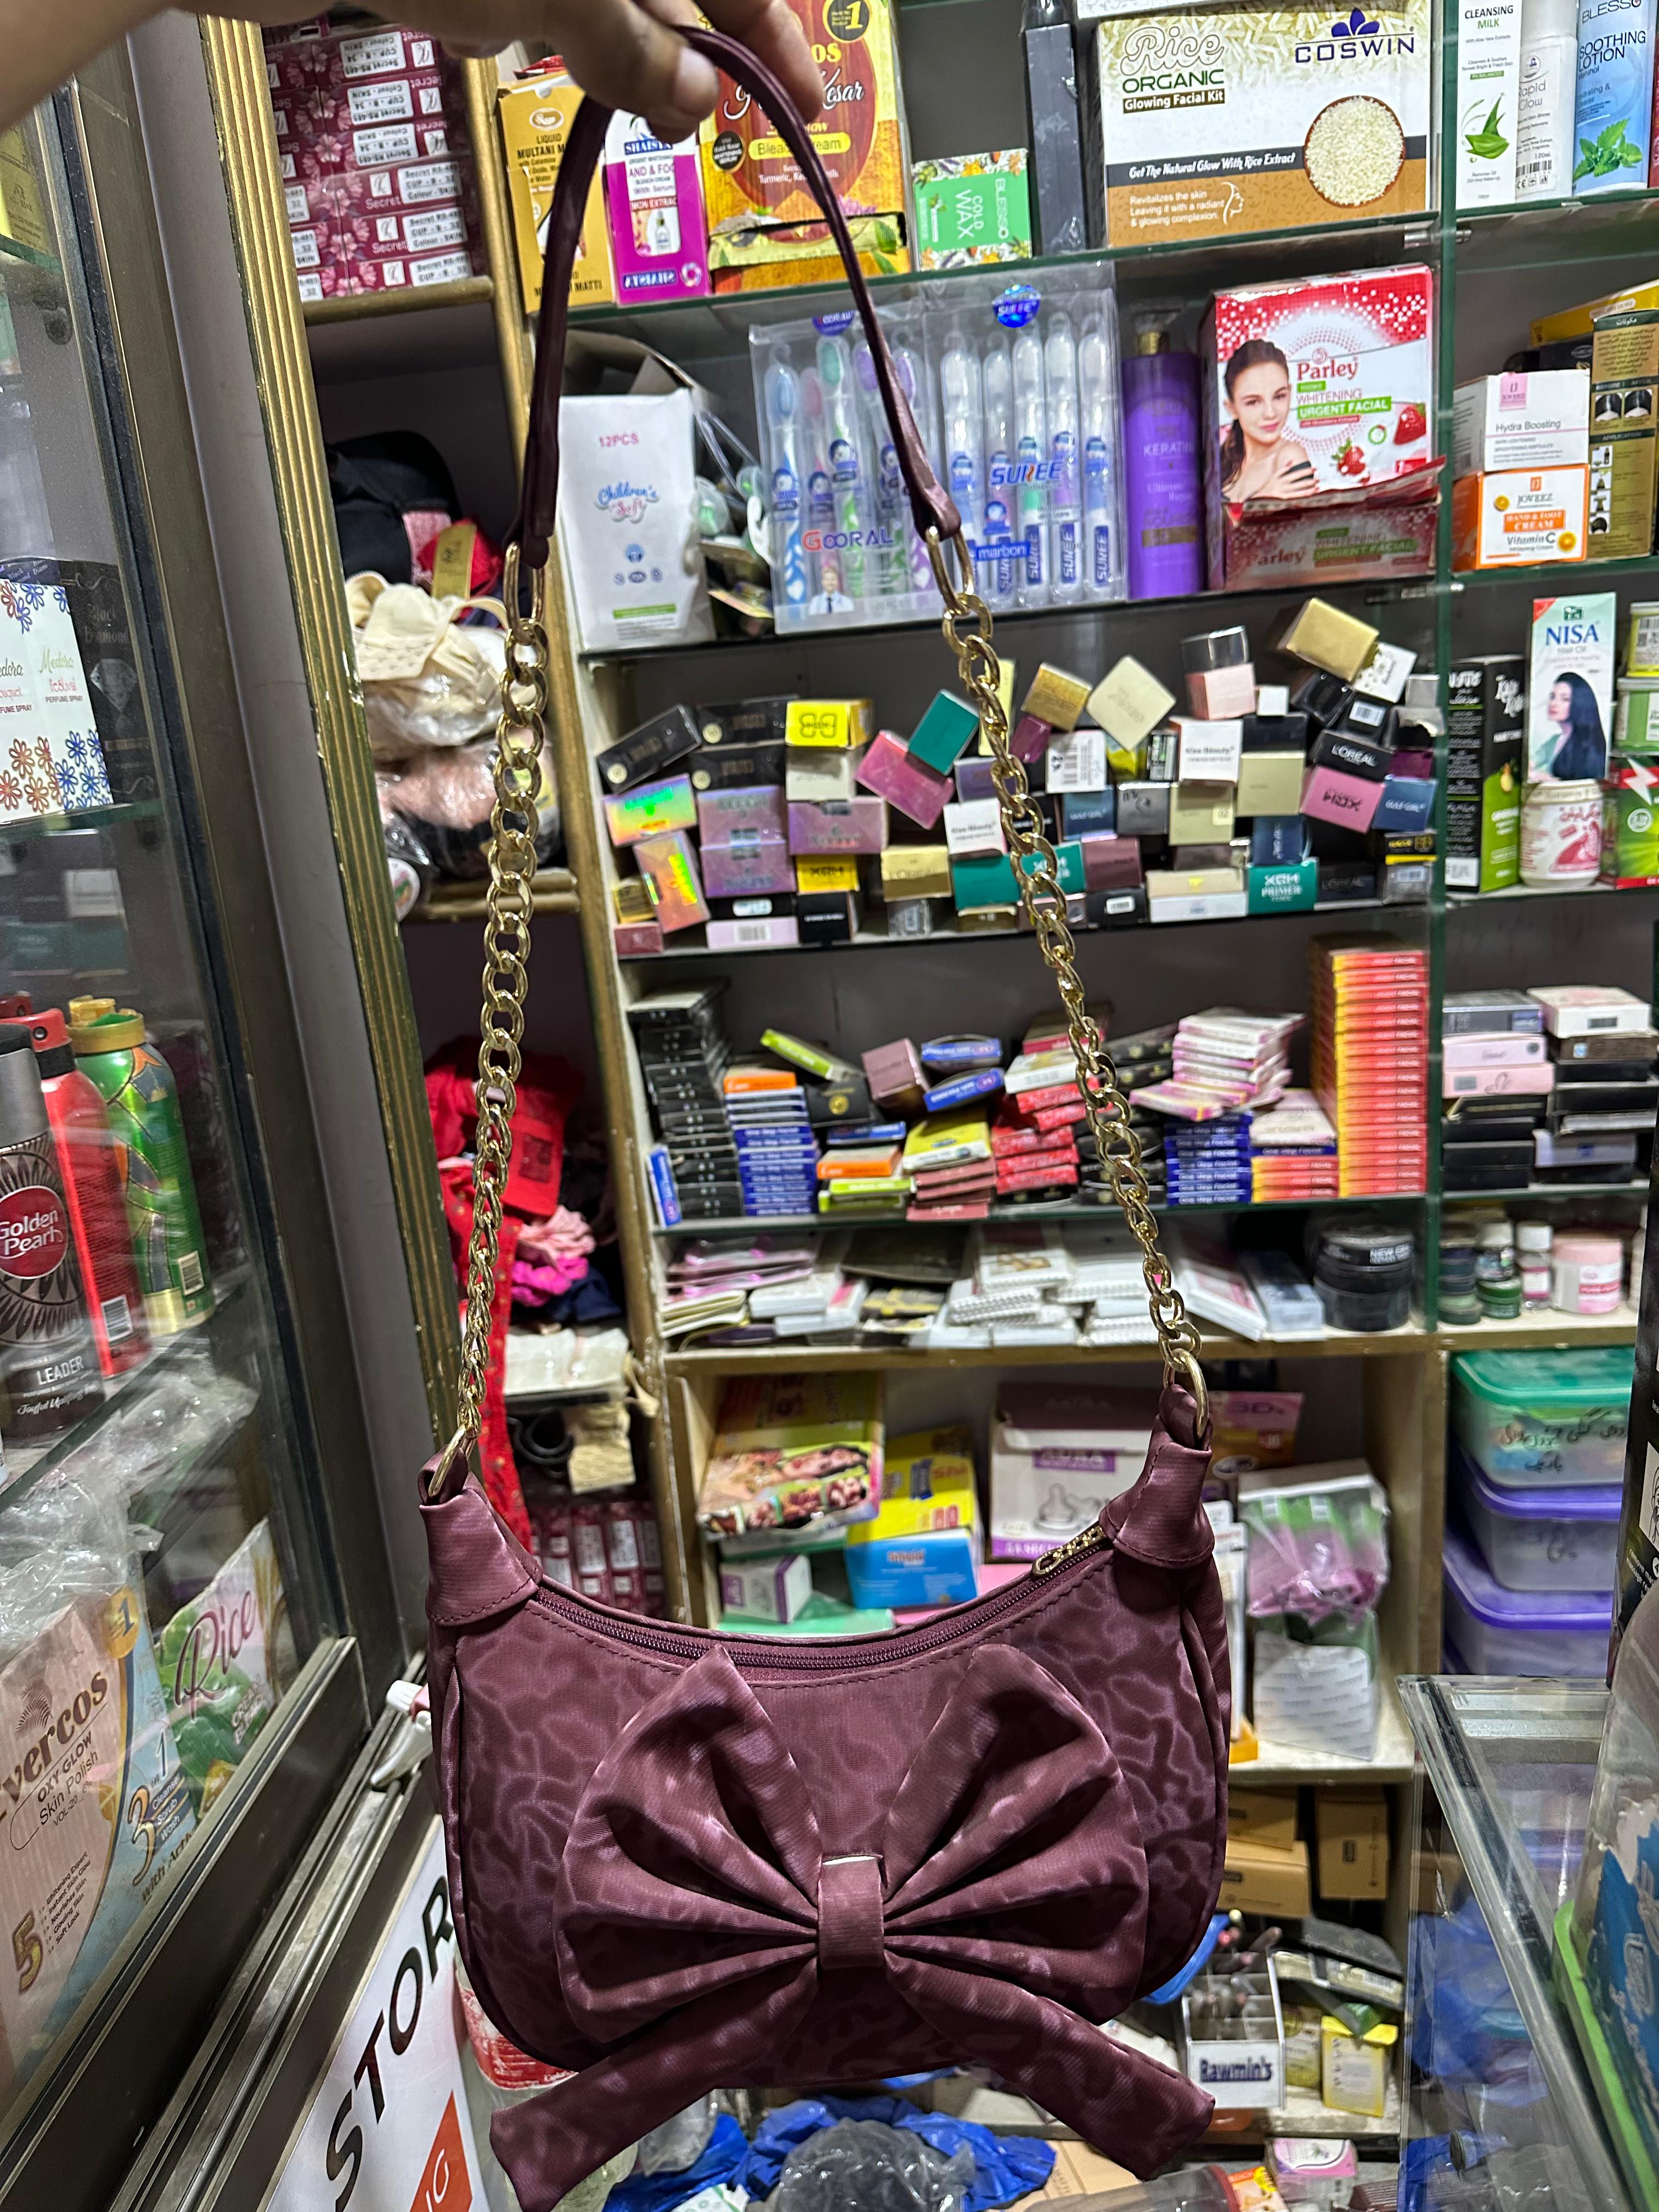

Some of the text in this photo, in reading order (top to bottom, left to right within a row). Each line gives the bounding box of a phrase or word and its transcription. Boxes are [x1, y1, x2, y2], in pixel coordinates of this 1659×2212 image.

[845, 1, 862, 29] 1
[1465, 5, 1514, 19] CLEANSING
[1477, 19, 1499, 29] MILK
[1582, 0, 1641, 24] BLESSO
[1120, 26, 1224, 76] Rice
[1295, 36, 1415, 64] COSWIN
[1579, 31, 1646, 60] SOOTHING
[1579, 46, 1625, 72] LOTION
[1122, 69, 1224, 93] ORGANIC
[1125, 91, 1223, 110] Glowing Facial Kit
[757, 142, 790, 155] Bleac
[630, 165, 647, 177] AND
[1129, 152, 1295, 178] Get The Natural Glow With Rice Extract
[956, 189, 974, 239] WAX
[972, 195, 984, 229] COLD
[1170, 202, 1188, 212] with
[1297, 358, 1359, 381] Parley
[1297, 388, 1362, 405] WHITENING
[1299, 399, 1387, 419] URGENT FACIAL
[1496, 419, 1562, 433] Hydra Boosting
[1514, 521, 1554, 531] CREAM
[1545, 532, 1556, 543] C
[1546, 623, 1599, 646] NISA
[0, 657, 23, 676] edora
[40, 648, 74, 673] Medora
[0, 686, 22, 701] ouquet
[0, 1210, 58, 1239] Golden
[4, 1228, 63, 1256] Pearl
[37, 1356, 84, 1385] LEADER
[17, 1399, 49, 1415] Joyful
[120, 1596, 135, 1637] 1
[174, 1590, 256, 1722] Rice
[0, 1671, 108, 1810] vercos
[37, 1730, 92, 1803] OXY GLOW
[40, 1750, 98, 1826] Skin Polish
[152, 1775, 180, 1810] Cleanser
[127, 1784, 156, 1887] 3
[156, 1729, 167, 1779] 1
[157, 1797, 178, 1826] Scrub
[160, 1815, 180, 1842] Wash
[70, 1852, 88, 1874] Expert
[49, 1860, 91, 1915] Instant Skin Glow
[73, 1893, 84, 1908] Skin
[51, 1877, 87, 1925] Nourishes Skin
[56, 1912, 80, 1944] Soft Look
[12, 1910, 43, 1994] 5
[326, 1875, 453, 2212] STOR
